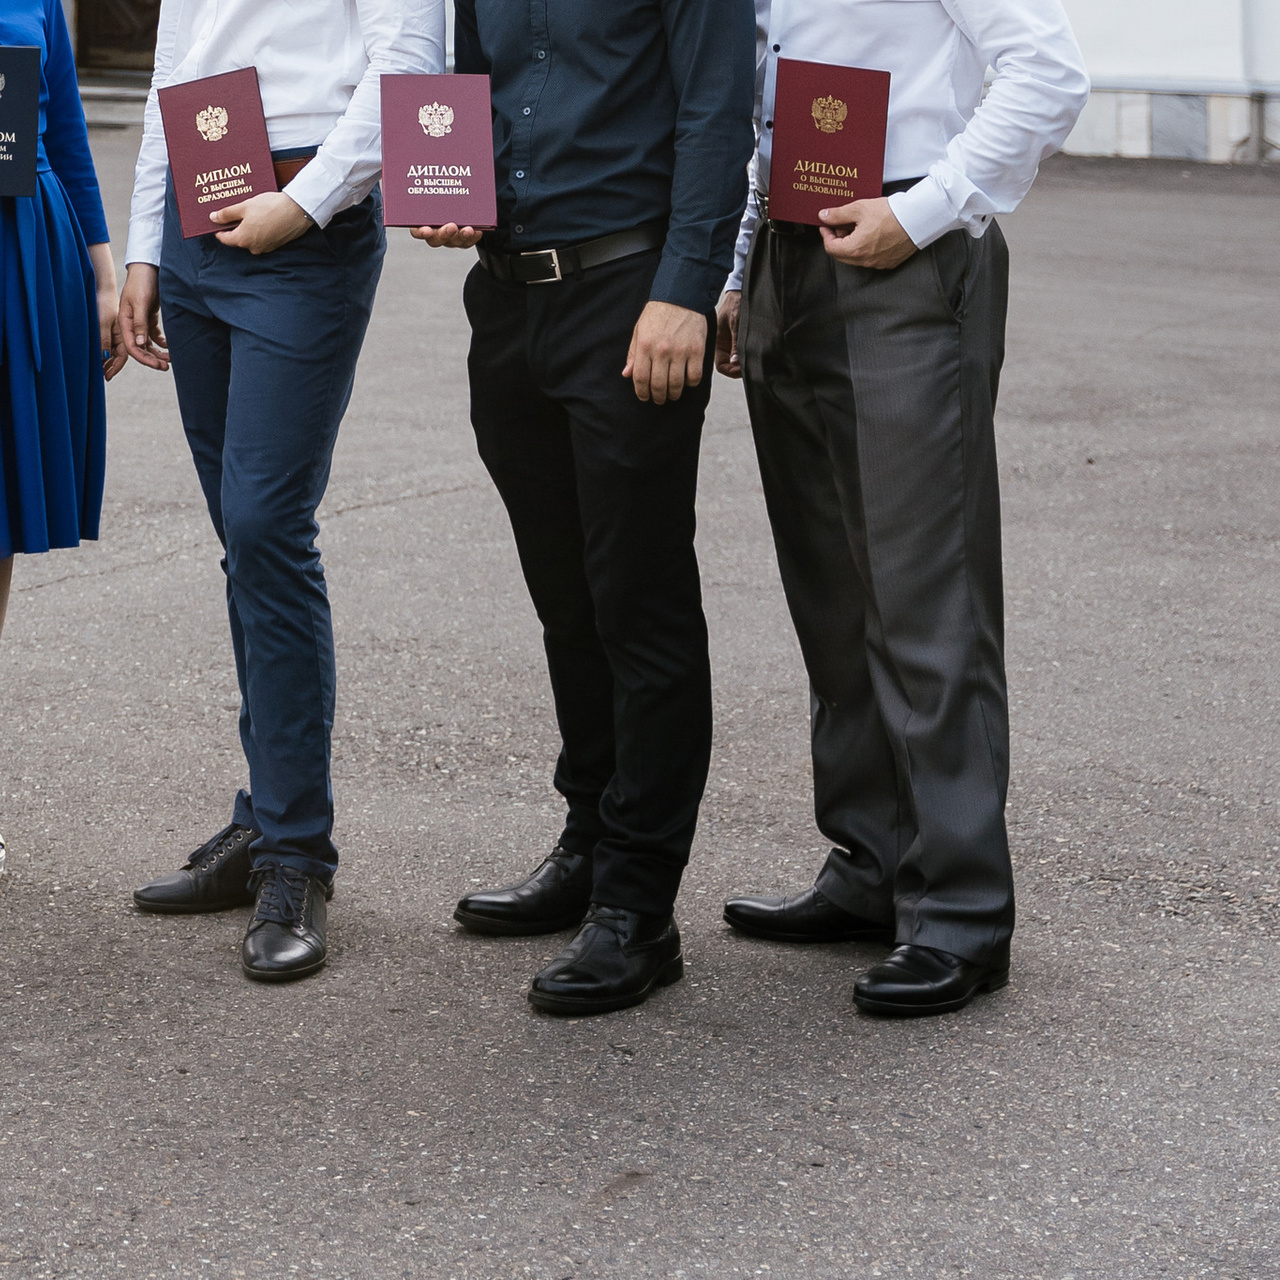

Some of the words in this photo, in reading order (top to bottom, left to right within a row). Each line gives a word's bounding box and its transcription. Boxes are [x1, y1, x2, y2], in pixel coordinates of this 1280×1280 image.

[195, 162, 252, 188] ДИПЛОМ
[407, 165, 472, 178] ДИПЛОМ
[793, 159, 858, 179] ДИПЛОМ
[202, 186, 209, 194] О
[210, 178, 245, 193] ВЫСШЕМ
[424, 178, 462, 187] ВЫСШЕМ
[800, 174, 807, 182] О
[809, 175, 848, 188] ВЫСШЕМ
[197, 185, 253, 204] ОБРАЗОВАНИИ
[408, 187, 470, 195] ОБРАЗОВАНИИ
[792, 182, 854, 198] ОБРАЗОВАНИИ
